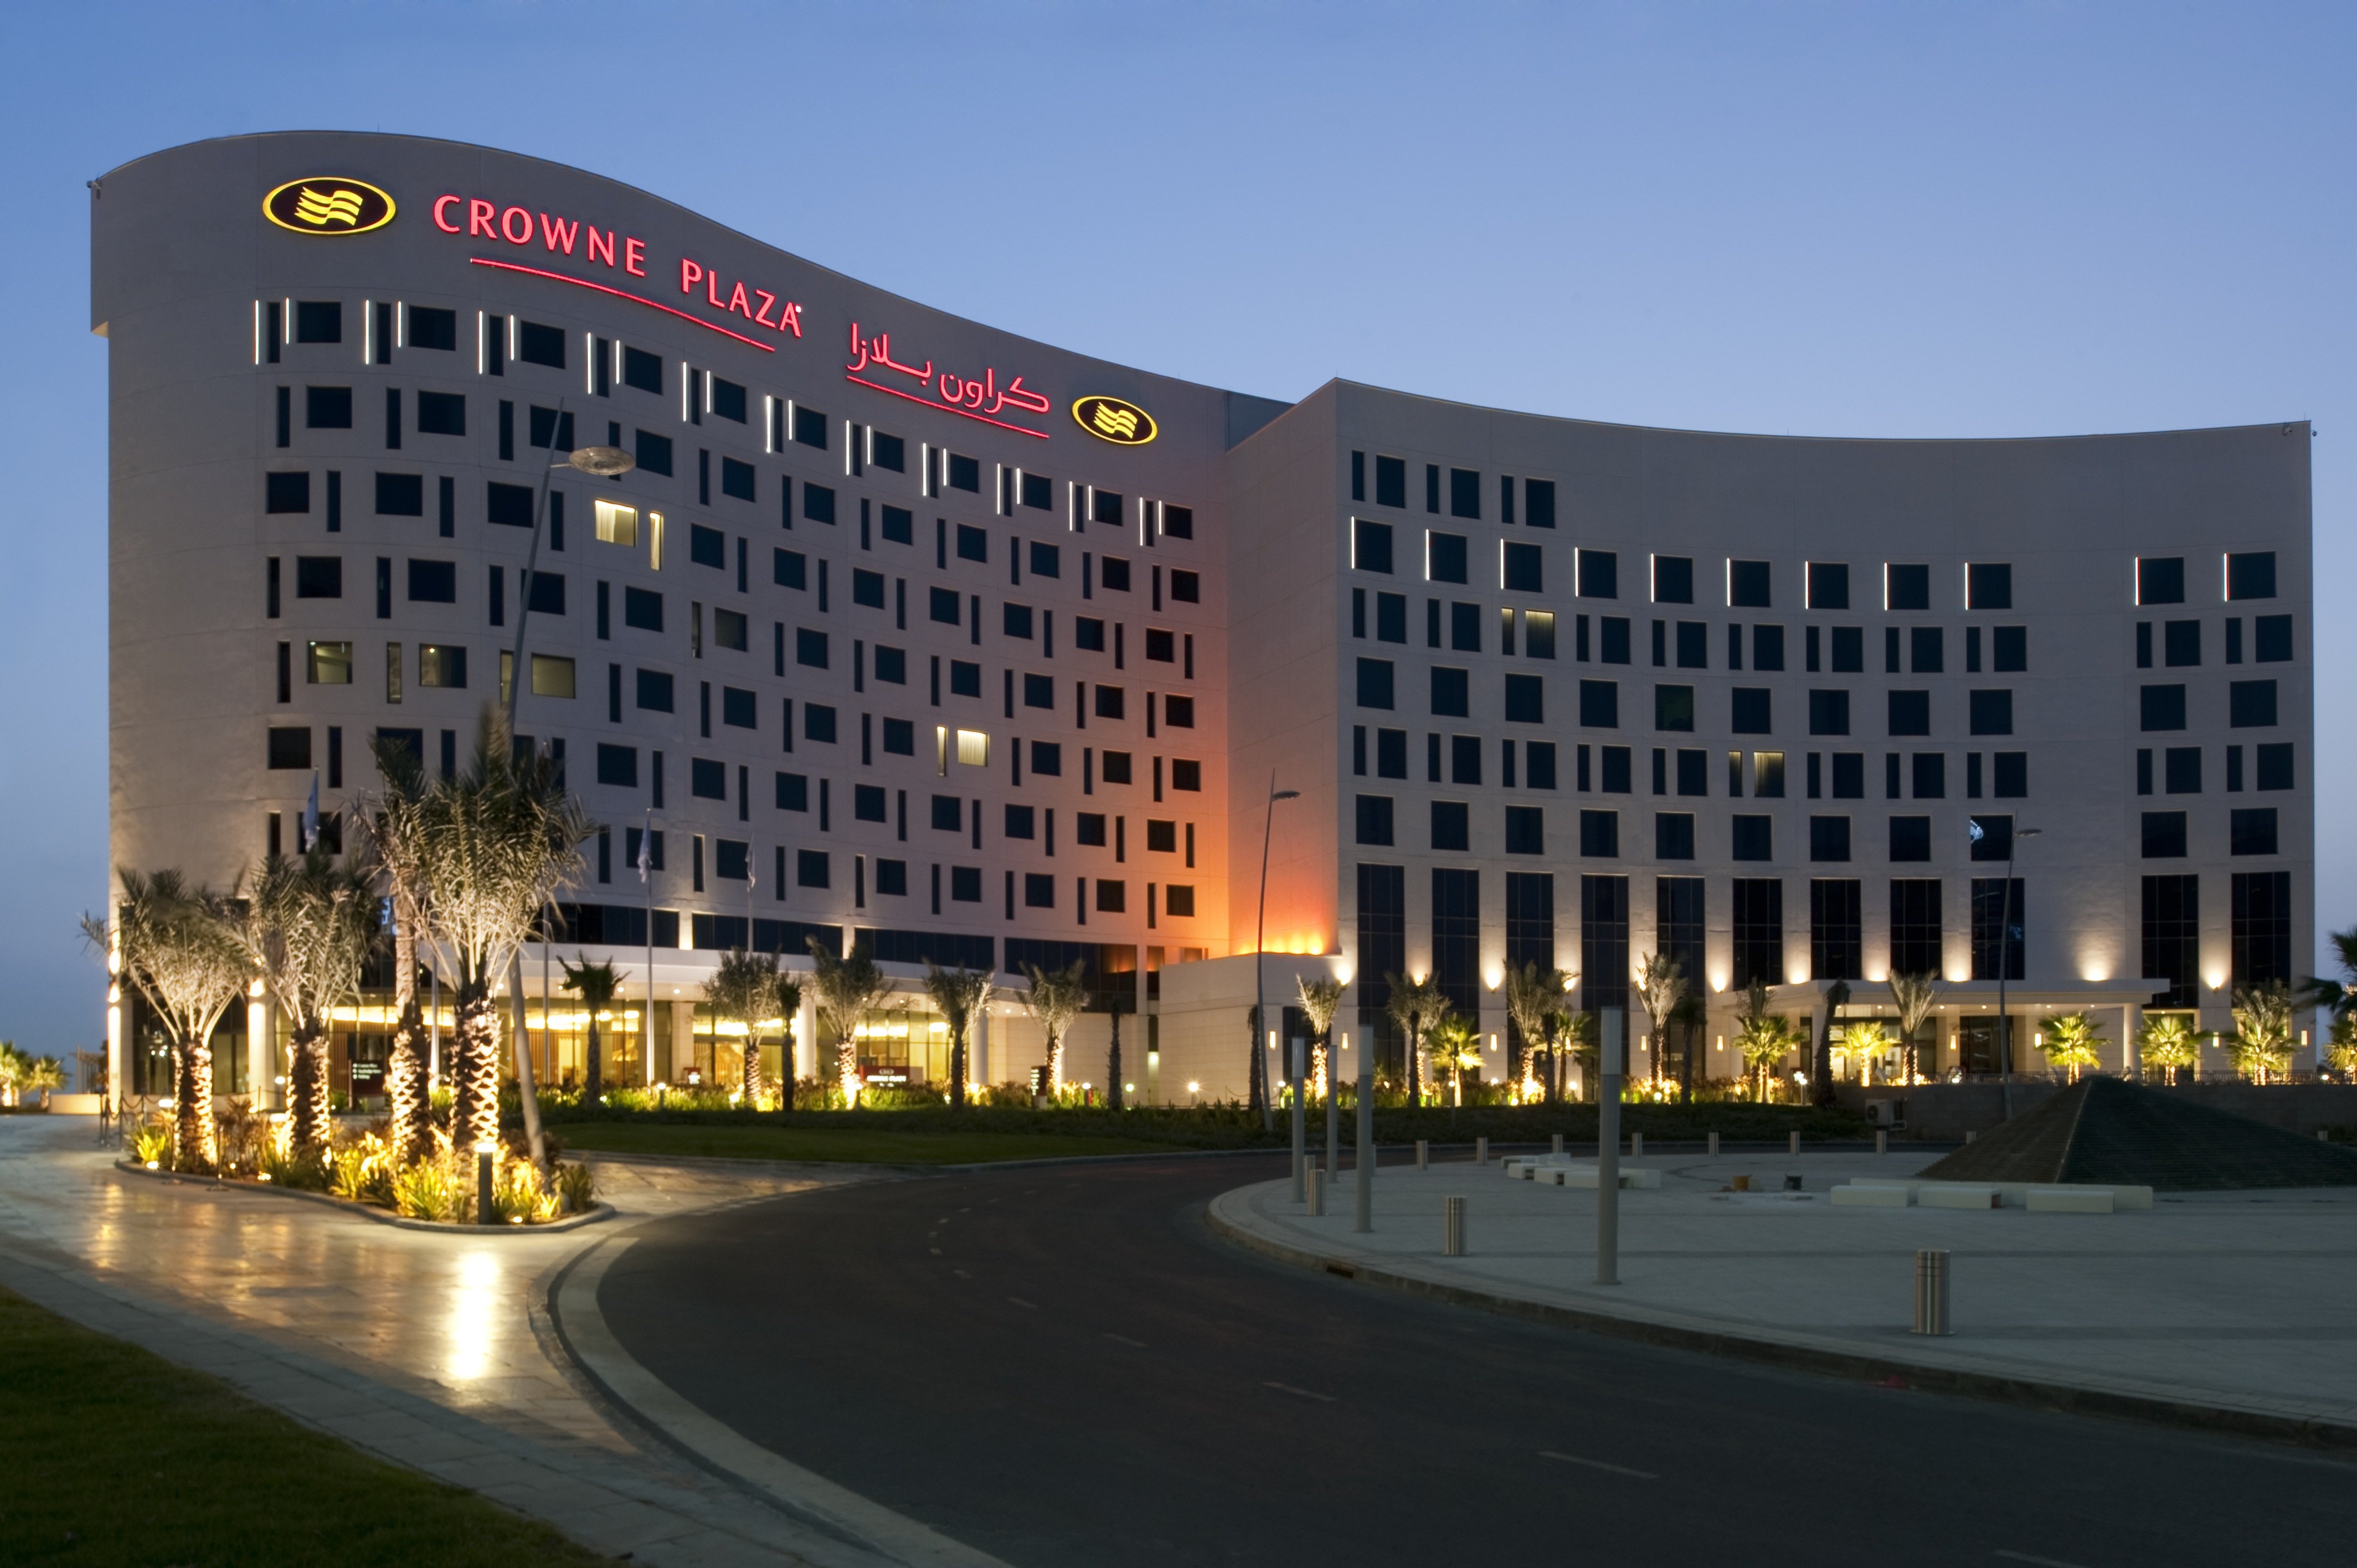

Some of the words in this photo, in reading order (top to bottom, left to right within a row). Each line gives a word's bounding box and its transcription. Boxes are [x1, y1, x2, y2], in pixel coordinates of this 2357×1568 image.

[433, 194, 646, 277] CROWNE
[681, 257, 802, 338] PLAZA
[846, 322, 933, 386] بلازا
[939, 368, 1051, 414] كراون
